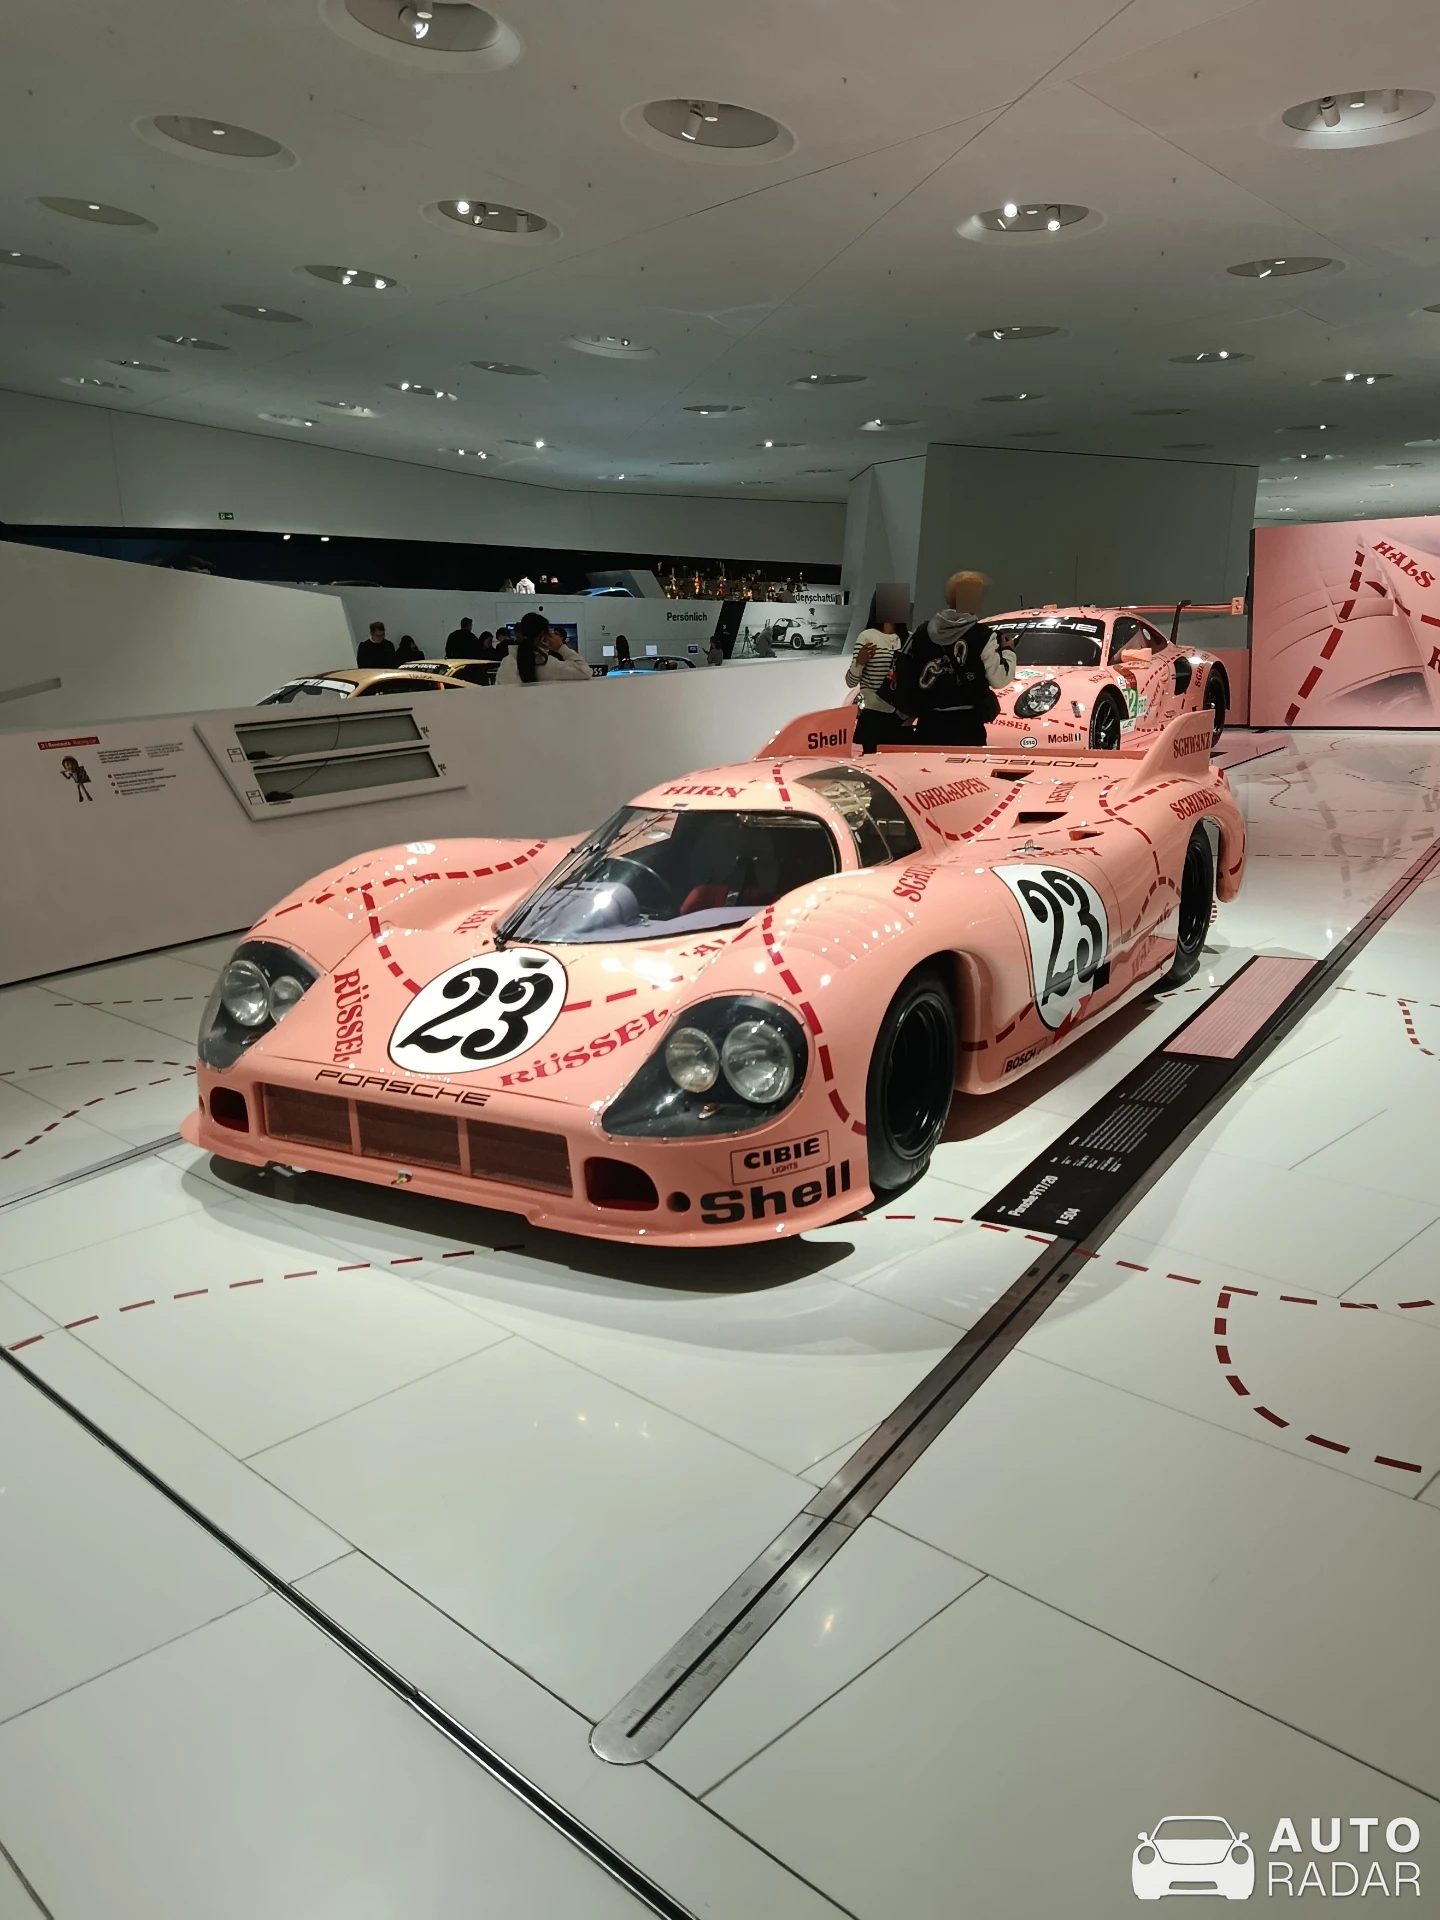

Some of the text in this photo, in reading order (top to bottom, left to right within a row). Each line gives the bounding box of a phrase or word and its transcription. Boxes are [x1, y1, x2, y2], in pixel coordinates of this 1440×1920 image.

[1372, 541, 1436, 588] HALS
[667, 611, 708, 622] Persönlich
[807, 728, 847, 750] Shell
[1022, 738, 1036, 747] Esso
[1048, 733, 1073, 744] Mobil
[1173, 731, 1211, 759] SCHWANZ
[945, 757, 1099, 768] PORSCHE
[661, 785, 747, 798] HIRN
[915, 777, 991, 810] OHRLAPPEN
[1017, 870, 1102, 1006] 23
[332, 968, 370, 1063] RÜSSEL
[395, 967, 554, 1060] 23
[500, 1008, 669, 1087] RÜSSEL
[1004, 1047, 1037, 1073] BOSCH
[315, 1069, 491, 1107] PORSCHE
[743, 1137, 820, 1169] CIBIE
[771, 1162, 798, 1175] LIGHTS
[700, 1159, 851, 1225] Shell
[1029, 1175, 1059, 1196] 917/20
